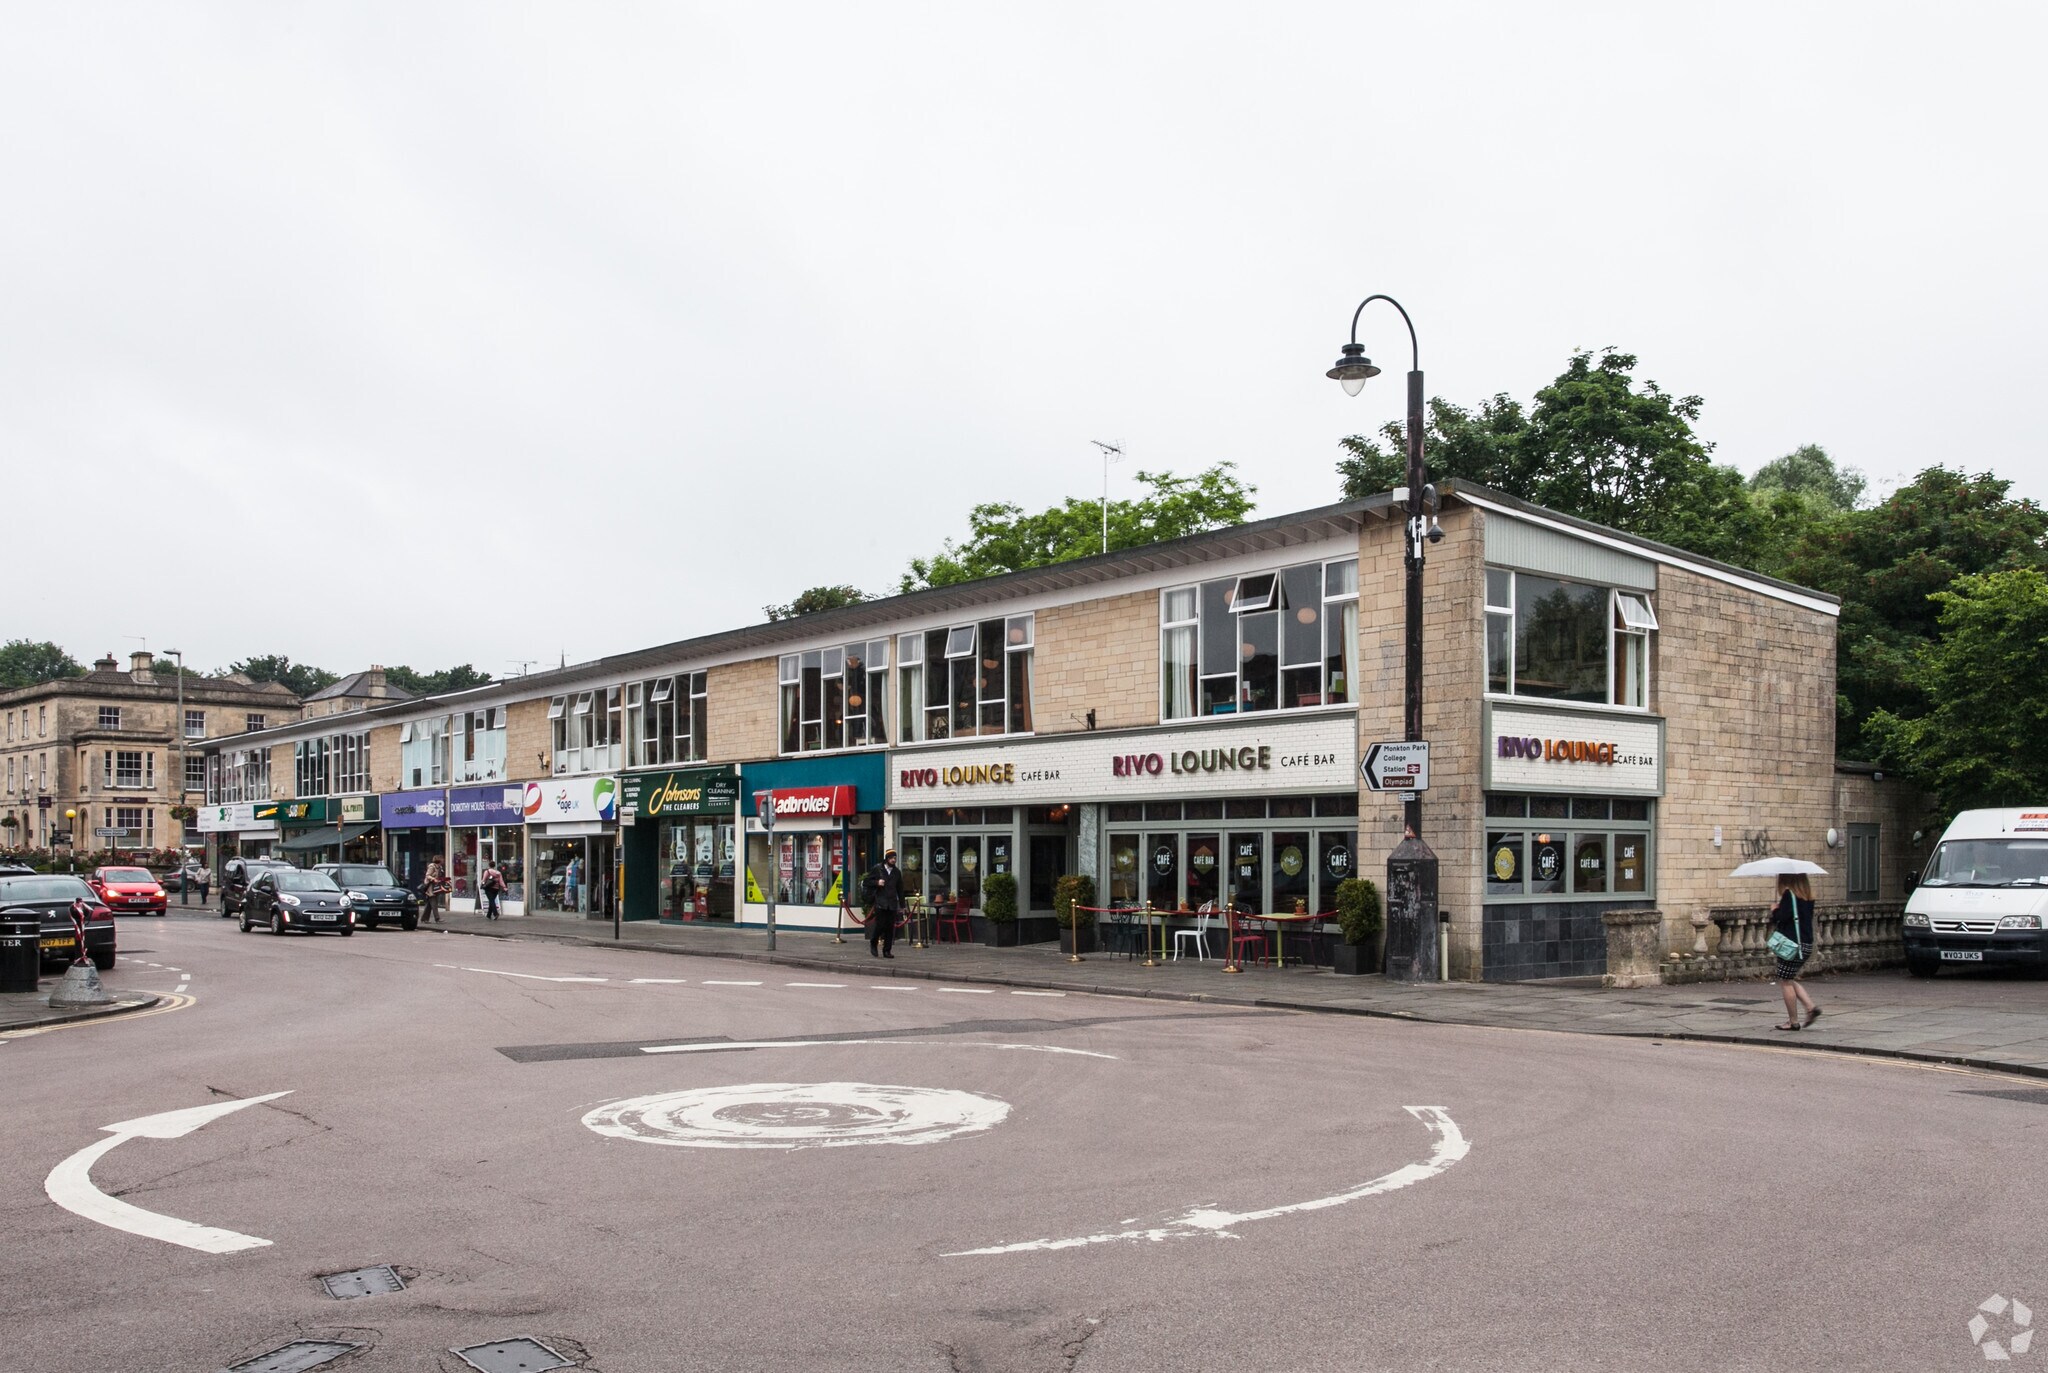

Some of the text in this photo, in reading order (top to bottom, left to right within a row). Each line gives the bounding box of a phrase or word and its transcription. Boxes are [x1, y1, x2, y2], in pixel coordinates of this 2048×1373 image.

[1498, 736, 1653, 766] RIVO LOUNGE CAFÉ BAR
[1112, 746, 1336, 776] RIVO LOUNGE CAFÉ BAR
[900, 764, 1060, 788] RIVO LOUNGE CAFÉ BAR
[648, 774, 701, 814] Johnsons
[451, 802, 470, 812] DOROTHY
[471, 801, 485, 811] HOUSE
[560, 800, 571, 813] age
[772, 796, 830, 813] Ladbrokes
[996, 845, 1005, 856] CAFÉ
[1240, 843, 1252, 855] CAFÉ
[1625, 846, 1635, 858] CAFÉ
[936, 853, 946, 863] CAFÉ
[1157, 852, 1170, 865] CAFÉ
[1194, 854, 1204, 864] CAFÉ
[1331, 852, 1347, 866] CAFÉ
[1542, 854, 1555, 868] CAFÉ
[1581, 857, 1590, 868] CAFÉ
[1241, 866, 1252, 876] BAR
[1625, 869, 1633, 879] BAR
